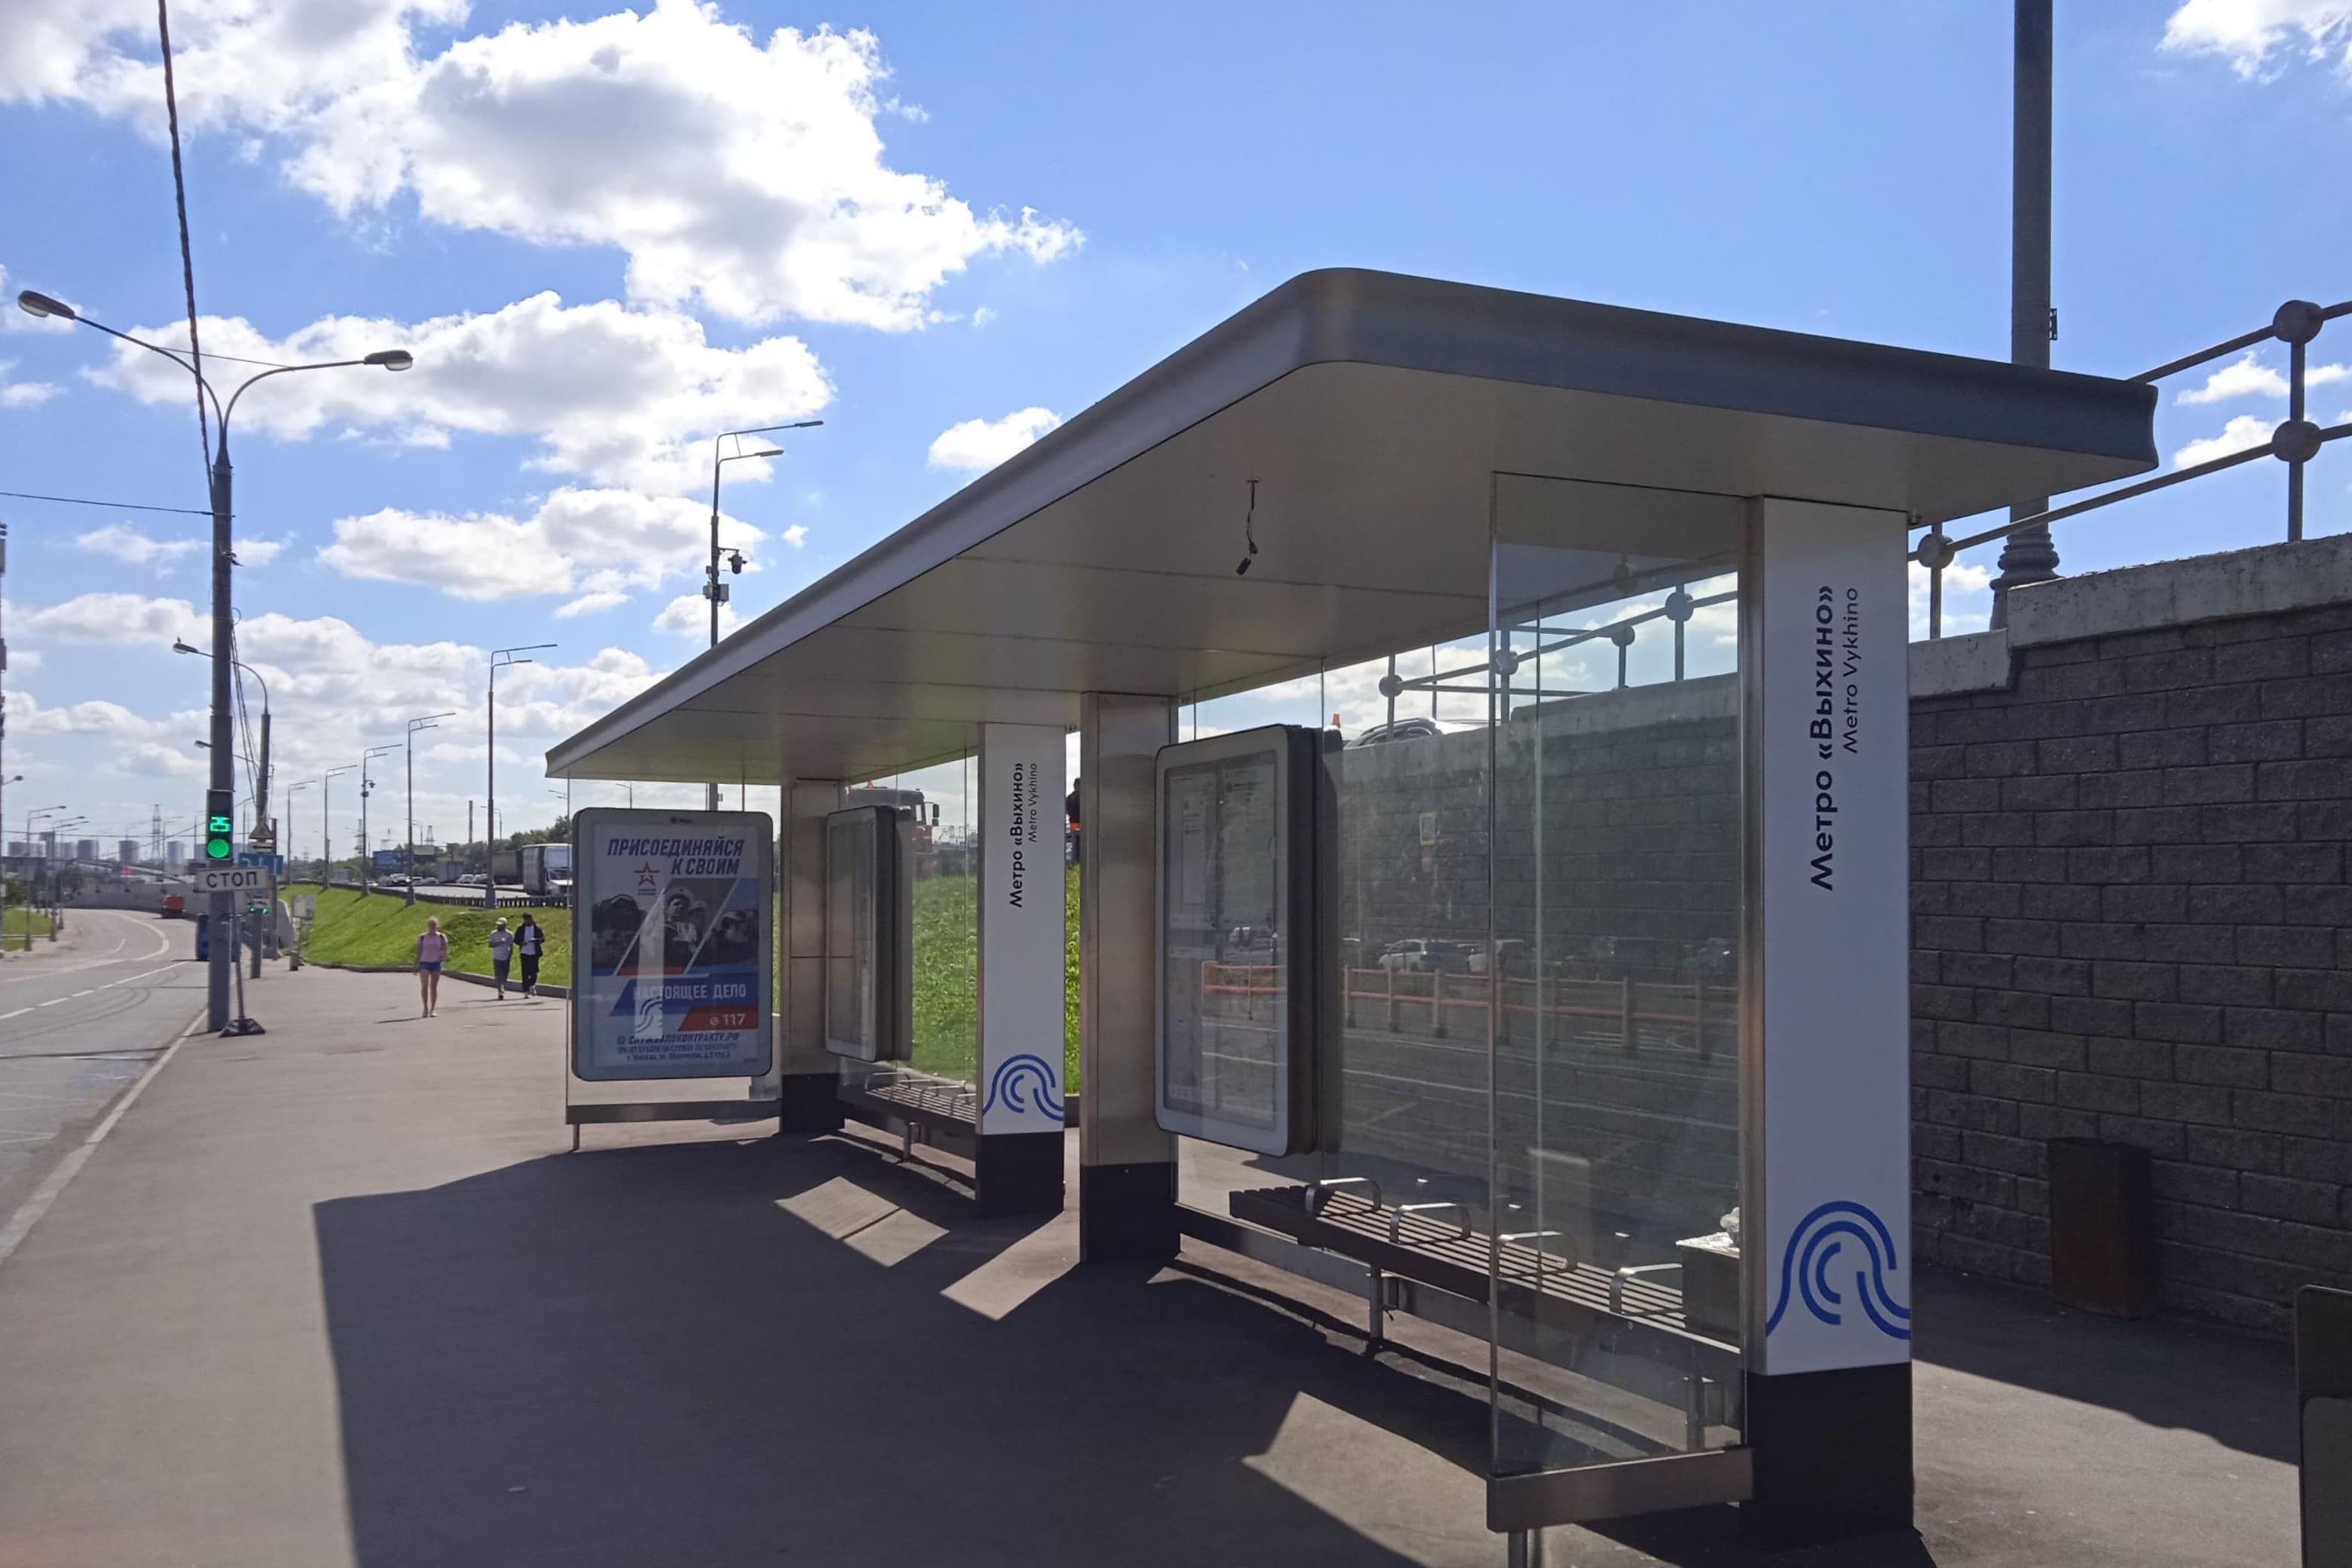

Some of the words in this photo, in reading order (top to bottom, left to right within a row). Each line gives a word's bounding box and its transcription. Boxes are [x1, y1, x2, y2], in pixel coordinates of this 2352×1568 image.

[1842, 587, 1861, 677] Vykhino
[1810, 586, 1833, 760] «Выхино»
[1842, 684, 1857, 754] Metro
[1010, 763, 1023, 846] «Выхино»
[1028, 763, 1039, 807] Vykhino
[607, 835, 745, 856] ПРИСОЕДИНЯЙСЯ
[1028, 809, 1037, 843] Metro
[1810, 770, 1838, 891] Метро
[206, 871, 257, 888] СТОП
[671, 859, 681, 875] К
[684, 858, 740, 875] СВОИМ
[1009, 850, 1025, 908] Метро
[712, 983, 746, 1000] ДЕЛО
[722, 1013, 746, 1026] 117
